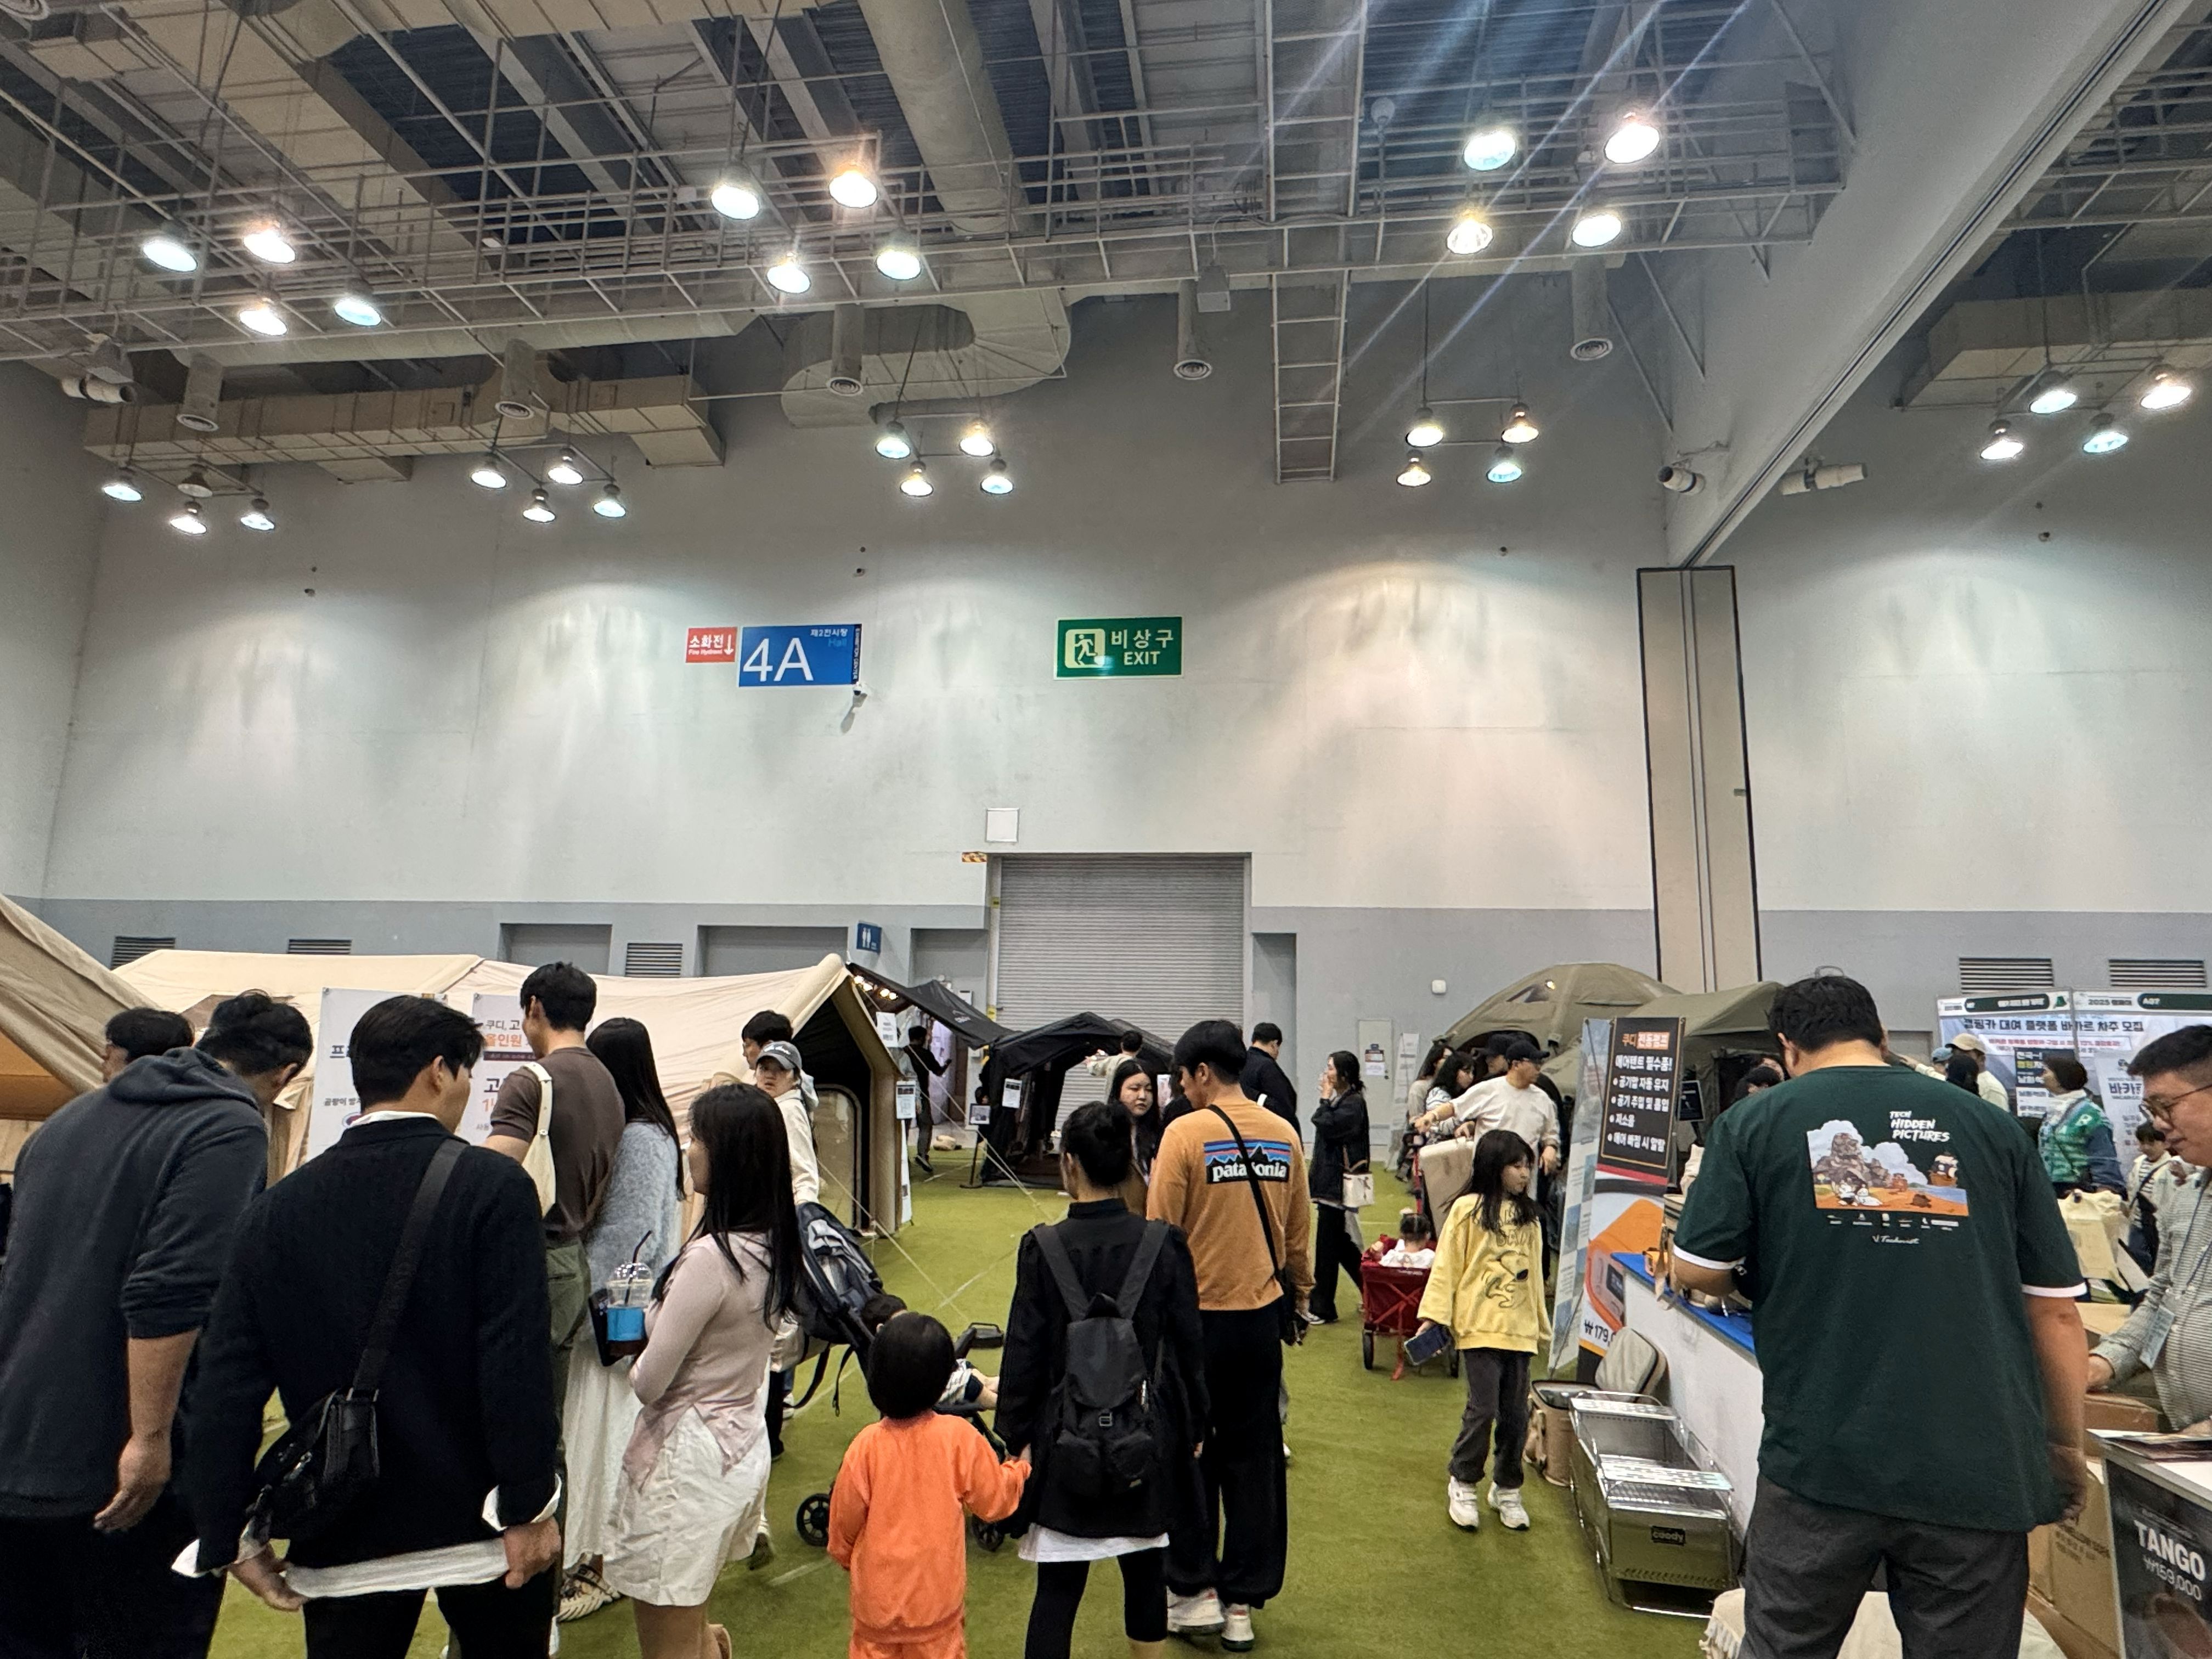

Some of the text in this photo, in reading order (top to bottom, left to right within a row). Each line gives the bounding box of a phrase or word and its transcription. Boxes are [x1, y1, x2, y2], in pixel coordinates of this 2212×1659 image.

[810, 629, 848, 637] 제2전시장
[1111, 629, 1174, 649] 비상구
[689, 634, 724, 648] 소화전
[828, 638, 847, 647] Hall
[743, 637, 814, 681] 4A
[1124, 651, 1160, 665] EXIT
[1999, 1019, 2021, 1030] 대여
[2122, 1021, 2144, 1032] 모집
[1615, 1055, 1673, 1071] 에어텐트 필수품!
[1639, 1077, 1653, 1091] 자동
[1654, 1078, 1669, 1092] 유지
[1891, 1119, 1936, 1130] HIDDEN
[1892, 1130, 1950, 1142] PICTURES
[1212, 1162, 1287, 1182] pataonia
[2134, 1520, 2205, 1581] TANGO
